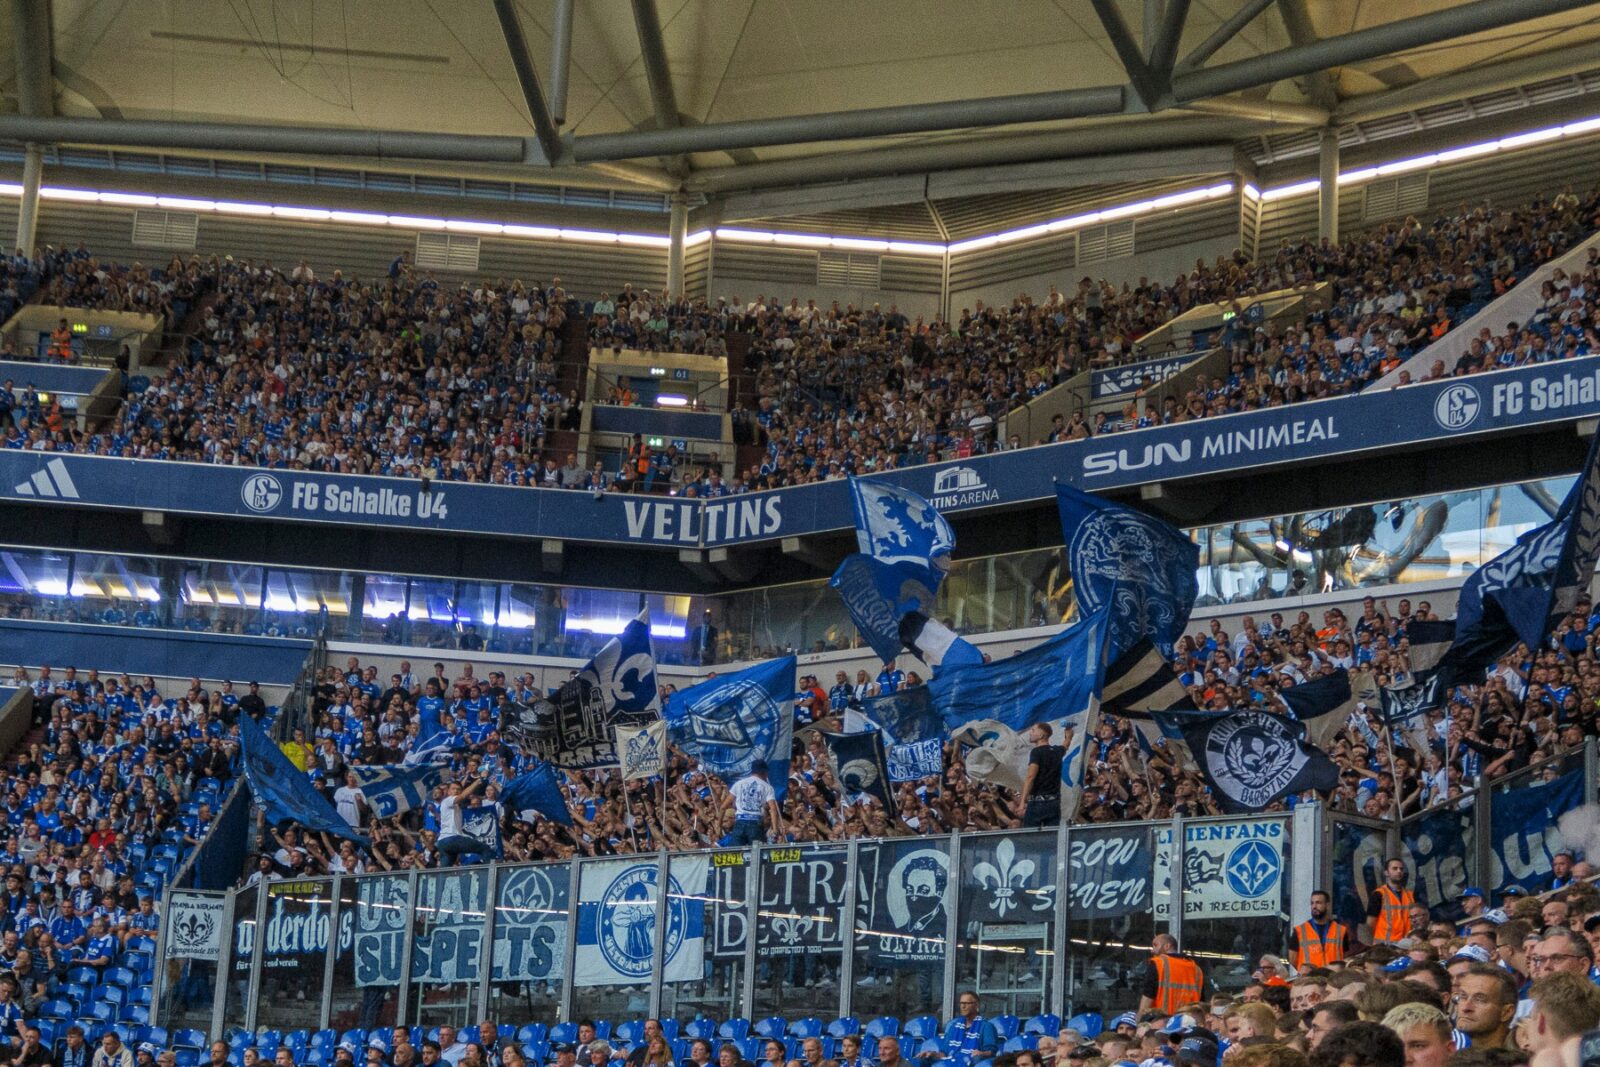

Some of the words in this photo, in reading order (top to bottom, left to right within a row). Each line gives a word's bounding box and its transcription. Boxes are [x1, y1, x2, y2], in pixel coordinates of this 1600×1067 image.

[676, 370, 686, 378] 61
[1493, 381, 1523, 417] FC
[1531, 368, 1600, 412] Schal
[1083, 438, 1190, 477] SUN
[1202, 417, 1340, 459] MINIMEAL
[292, 481, 318, 511] FC
[325, 484, 411, 518] Schalke
[417, 490, 448, 520] 04
[959, 488, 1000, 506] ARENA
[623, 495, 782, 543] VELTINS
[1158, 823, 1281, 844] LIIENFANS
[1070, 837, 1140, 869] ROW
